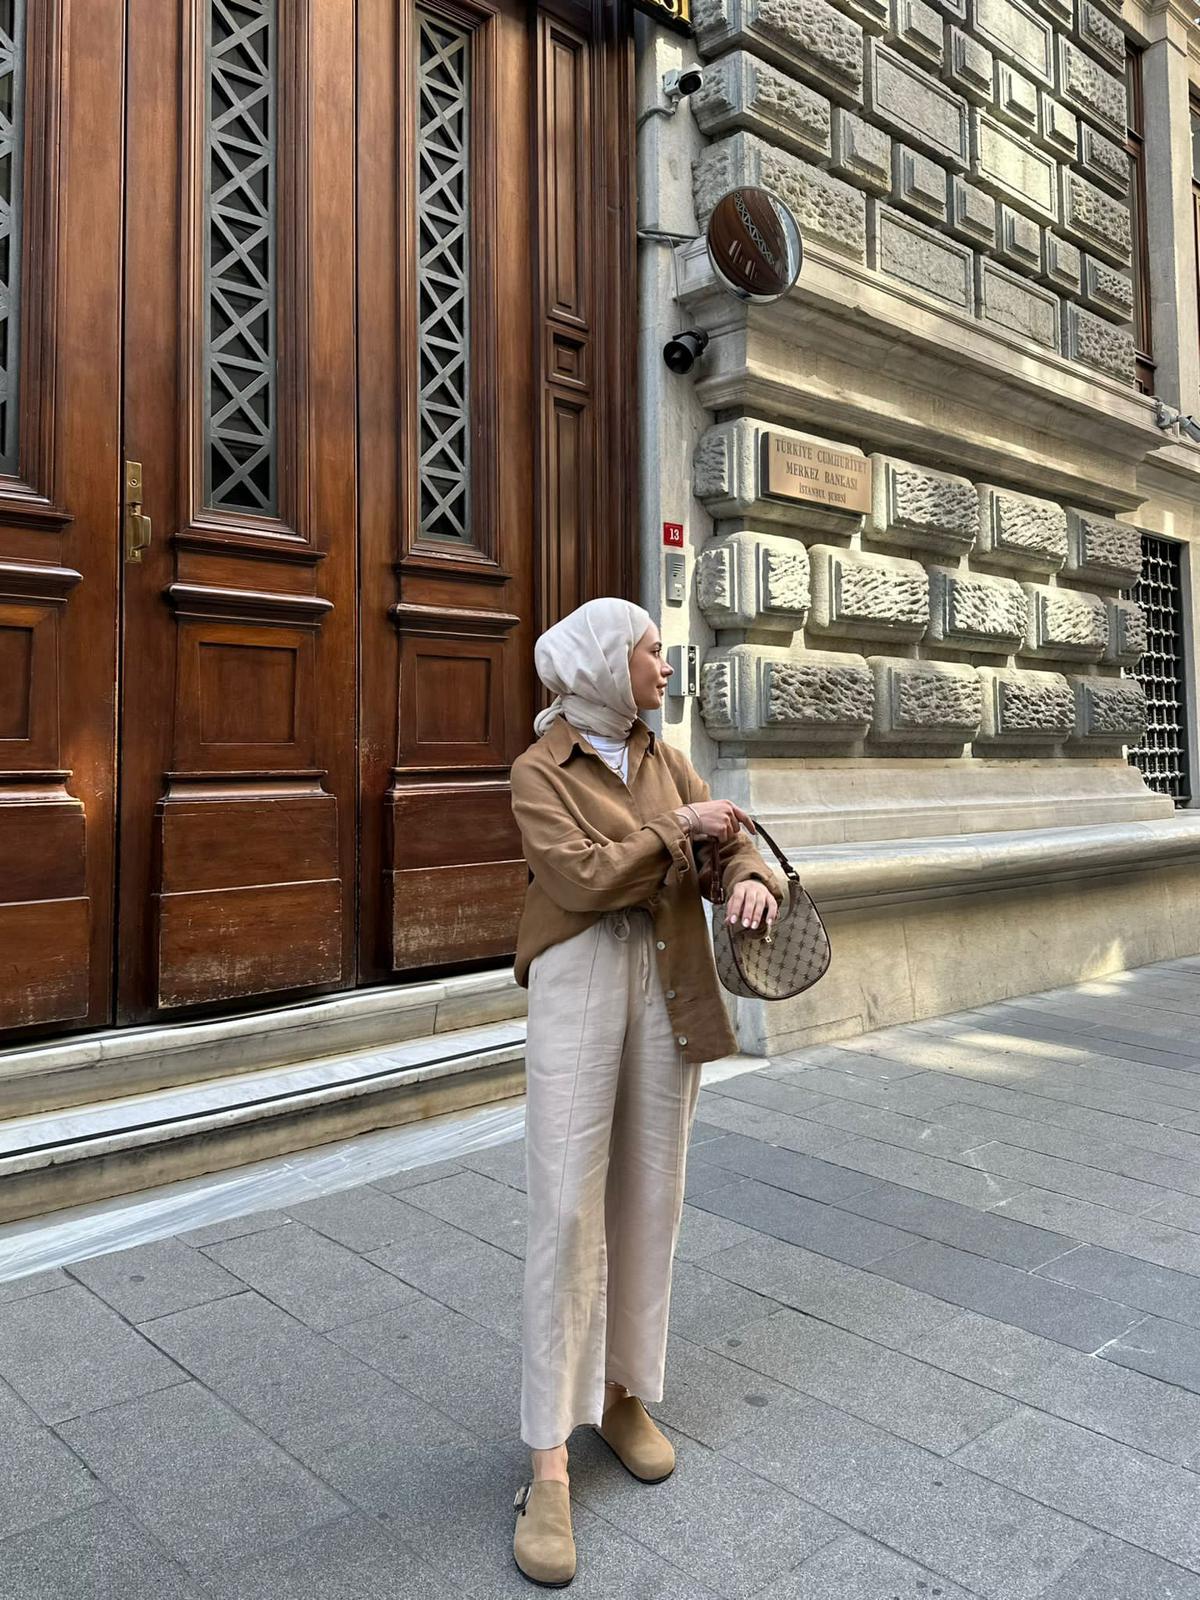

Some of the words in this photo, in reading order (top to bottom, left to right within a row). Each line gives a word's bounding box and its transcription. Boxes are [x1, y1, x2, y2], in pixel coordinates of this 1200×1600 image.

[775, 438, 813, 460] TÜRKİYE
[785, 460, 820, 481] MERKEZ
[824, 471, 858, 491] BANKASI
[670, 528, 680, 541] 13
